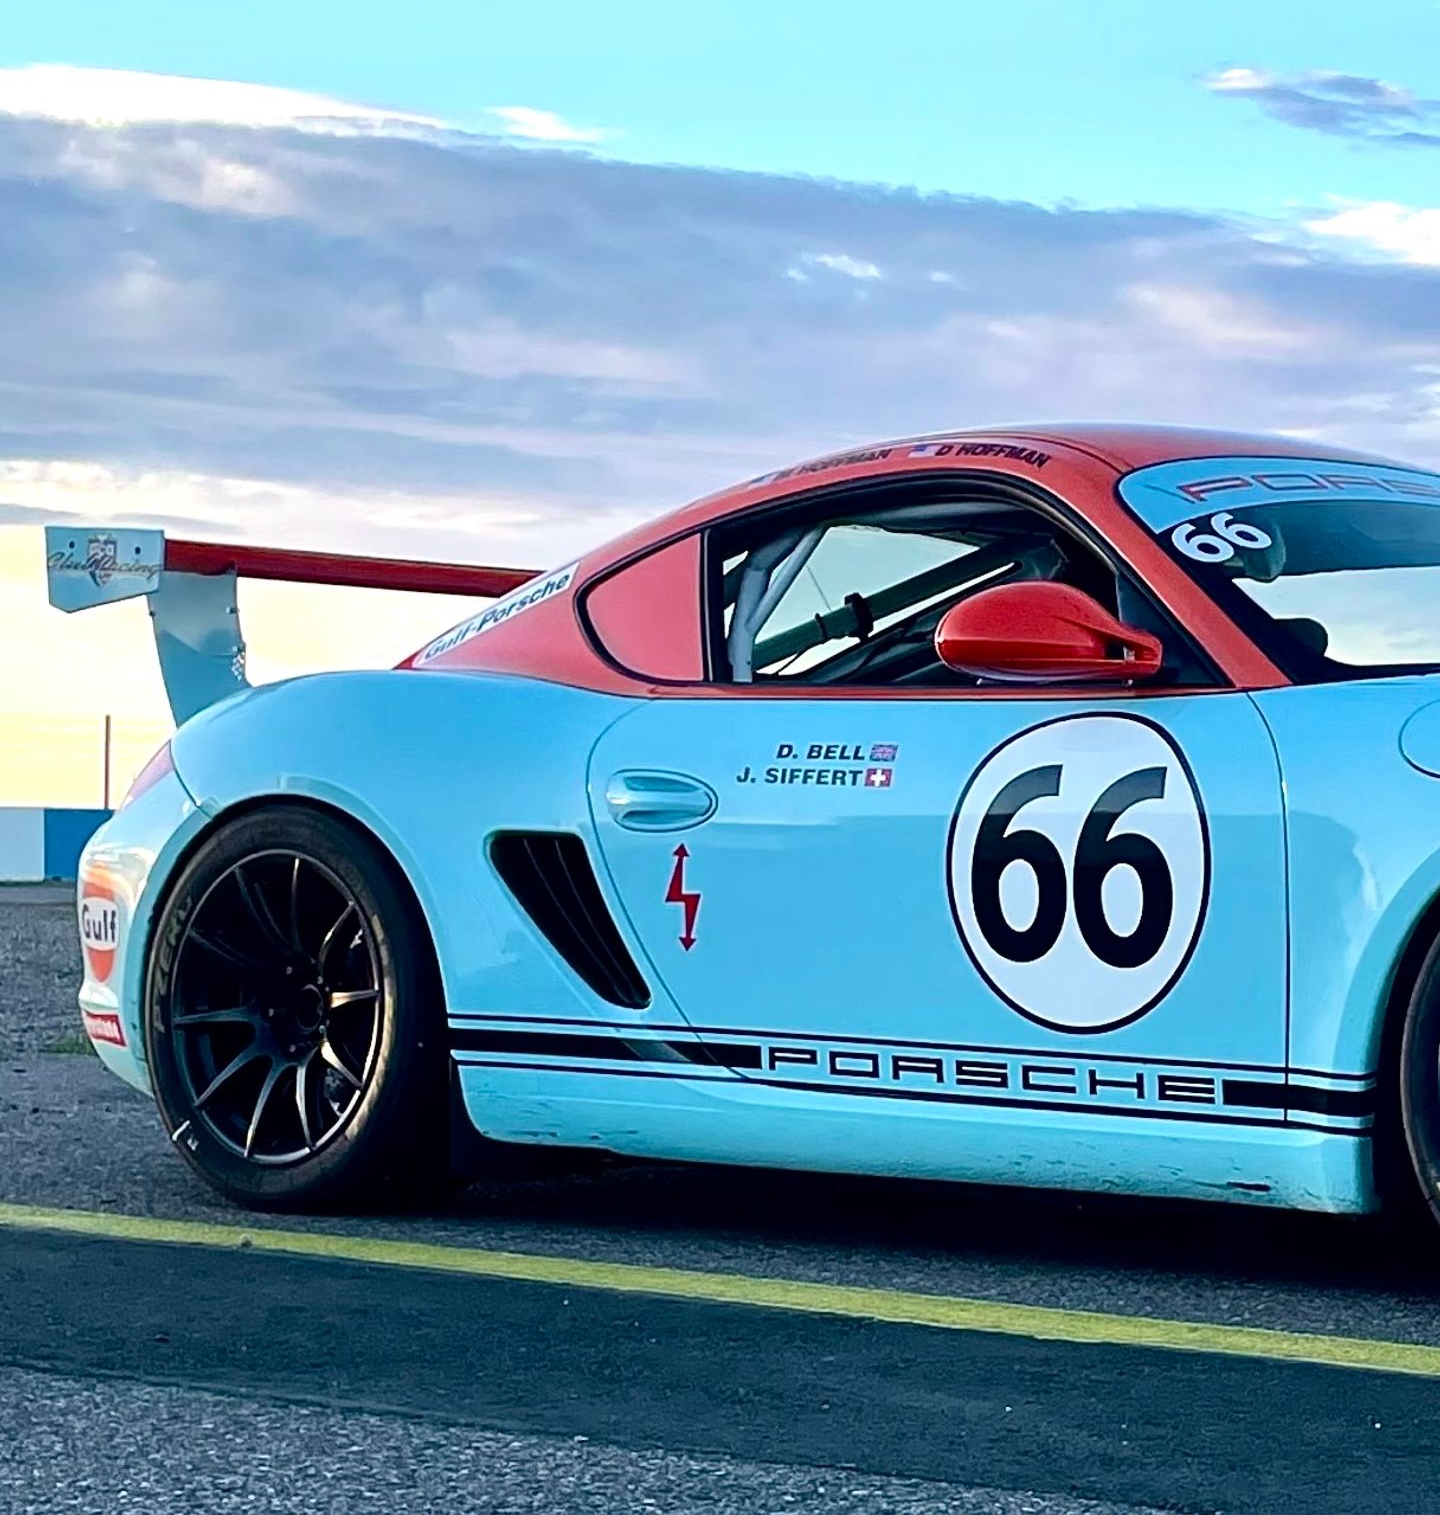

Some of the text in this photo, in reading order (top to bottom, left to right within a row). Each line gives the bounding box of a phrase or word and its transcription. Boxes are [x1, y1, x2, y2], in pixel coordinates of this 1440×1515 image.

[934, 442, 1052, 468] D HOFFMAN
[1172, 511, 1272, 563] 66
[424, 573, 570, 660] Gulf-Porsche
[776, 744, 866, 761] D. BELL
[736, 767, 864, 786] J. SIFFERT
[971, 764, 1174, 969] 66
[82, 904, 117, 943] Gulf
[768, 1046, 1216, 1105] PORSCHE
